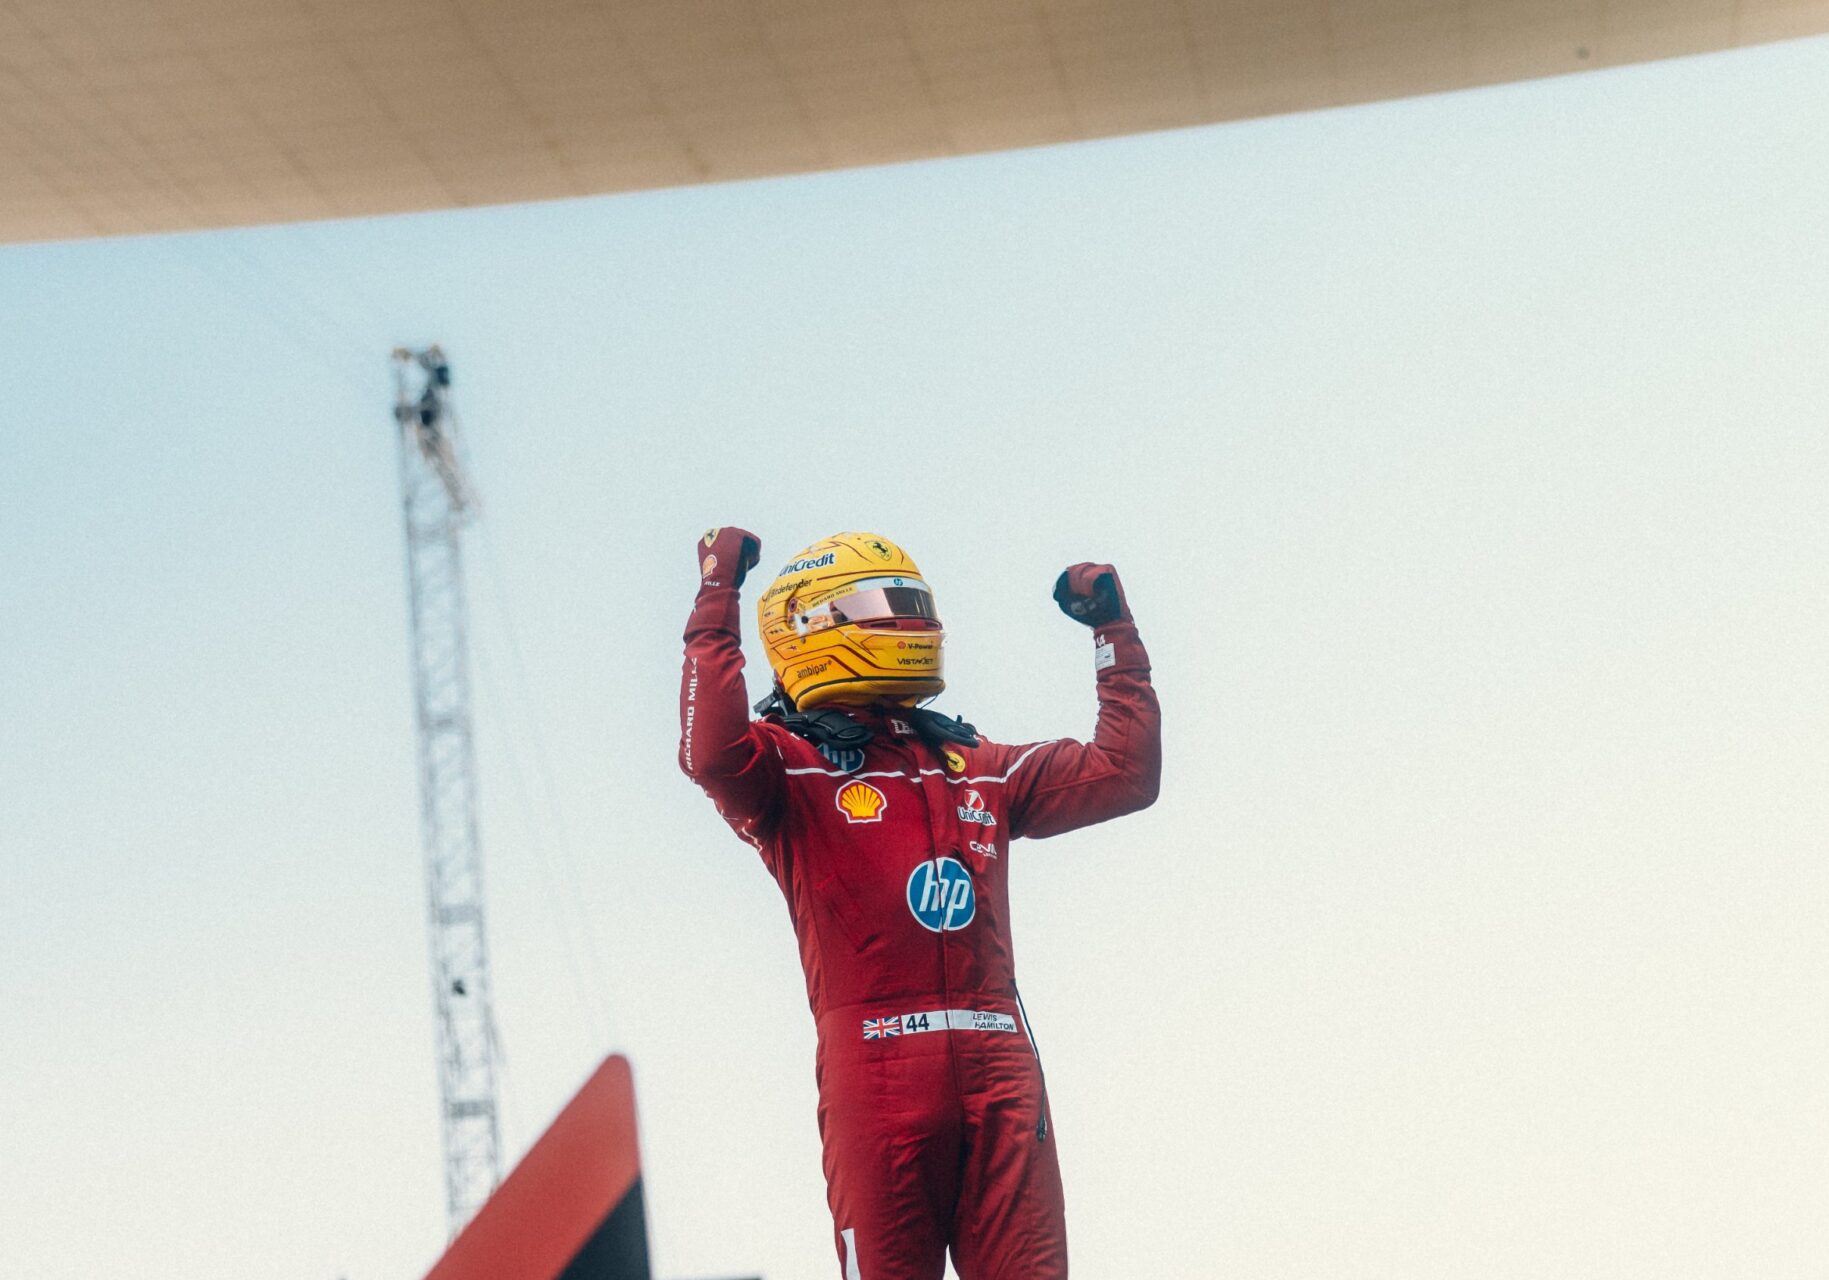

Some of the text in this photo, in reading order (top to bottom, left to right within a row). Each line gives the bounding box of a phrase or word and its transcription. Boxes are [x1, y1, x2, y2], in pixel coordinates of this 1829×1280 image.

[683, 705, 695, 771] RICHARD
[912, 858, 973, 931] hp
[906, 1014, 930, 1032] 44
[972, 1013, 998, 1022] LEWIS
[974, 1022, 1014, 1031] HAMILTON
